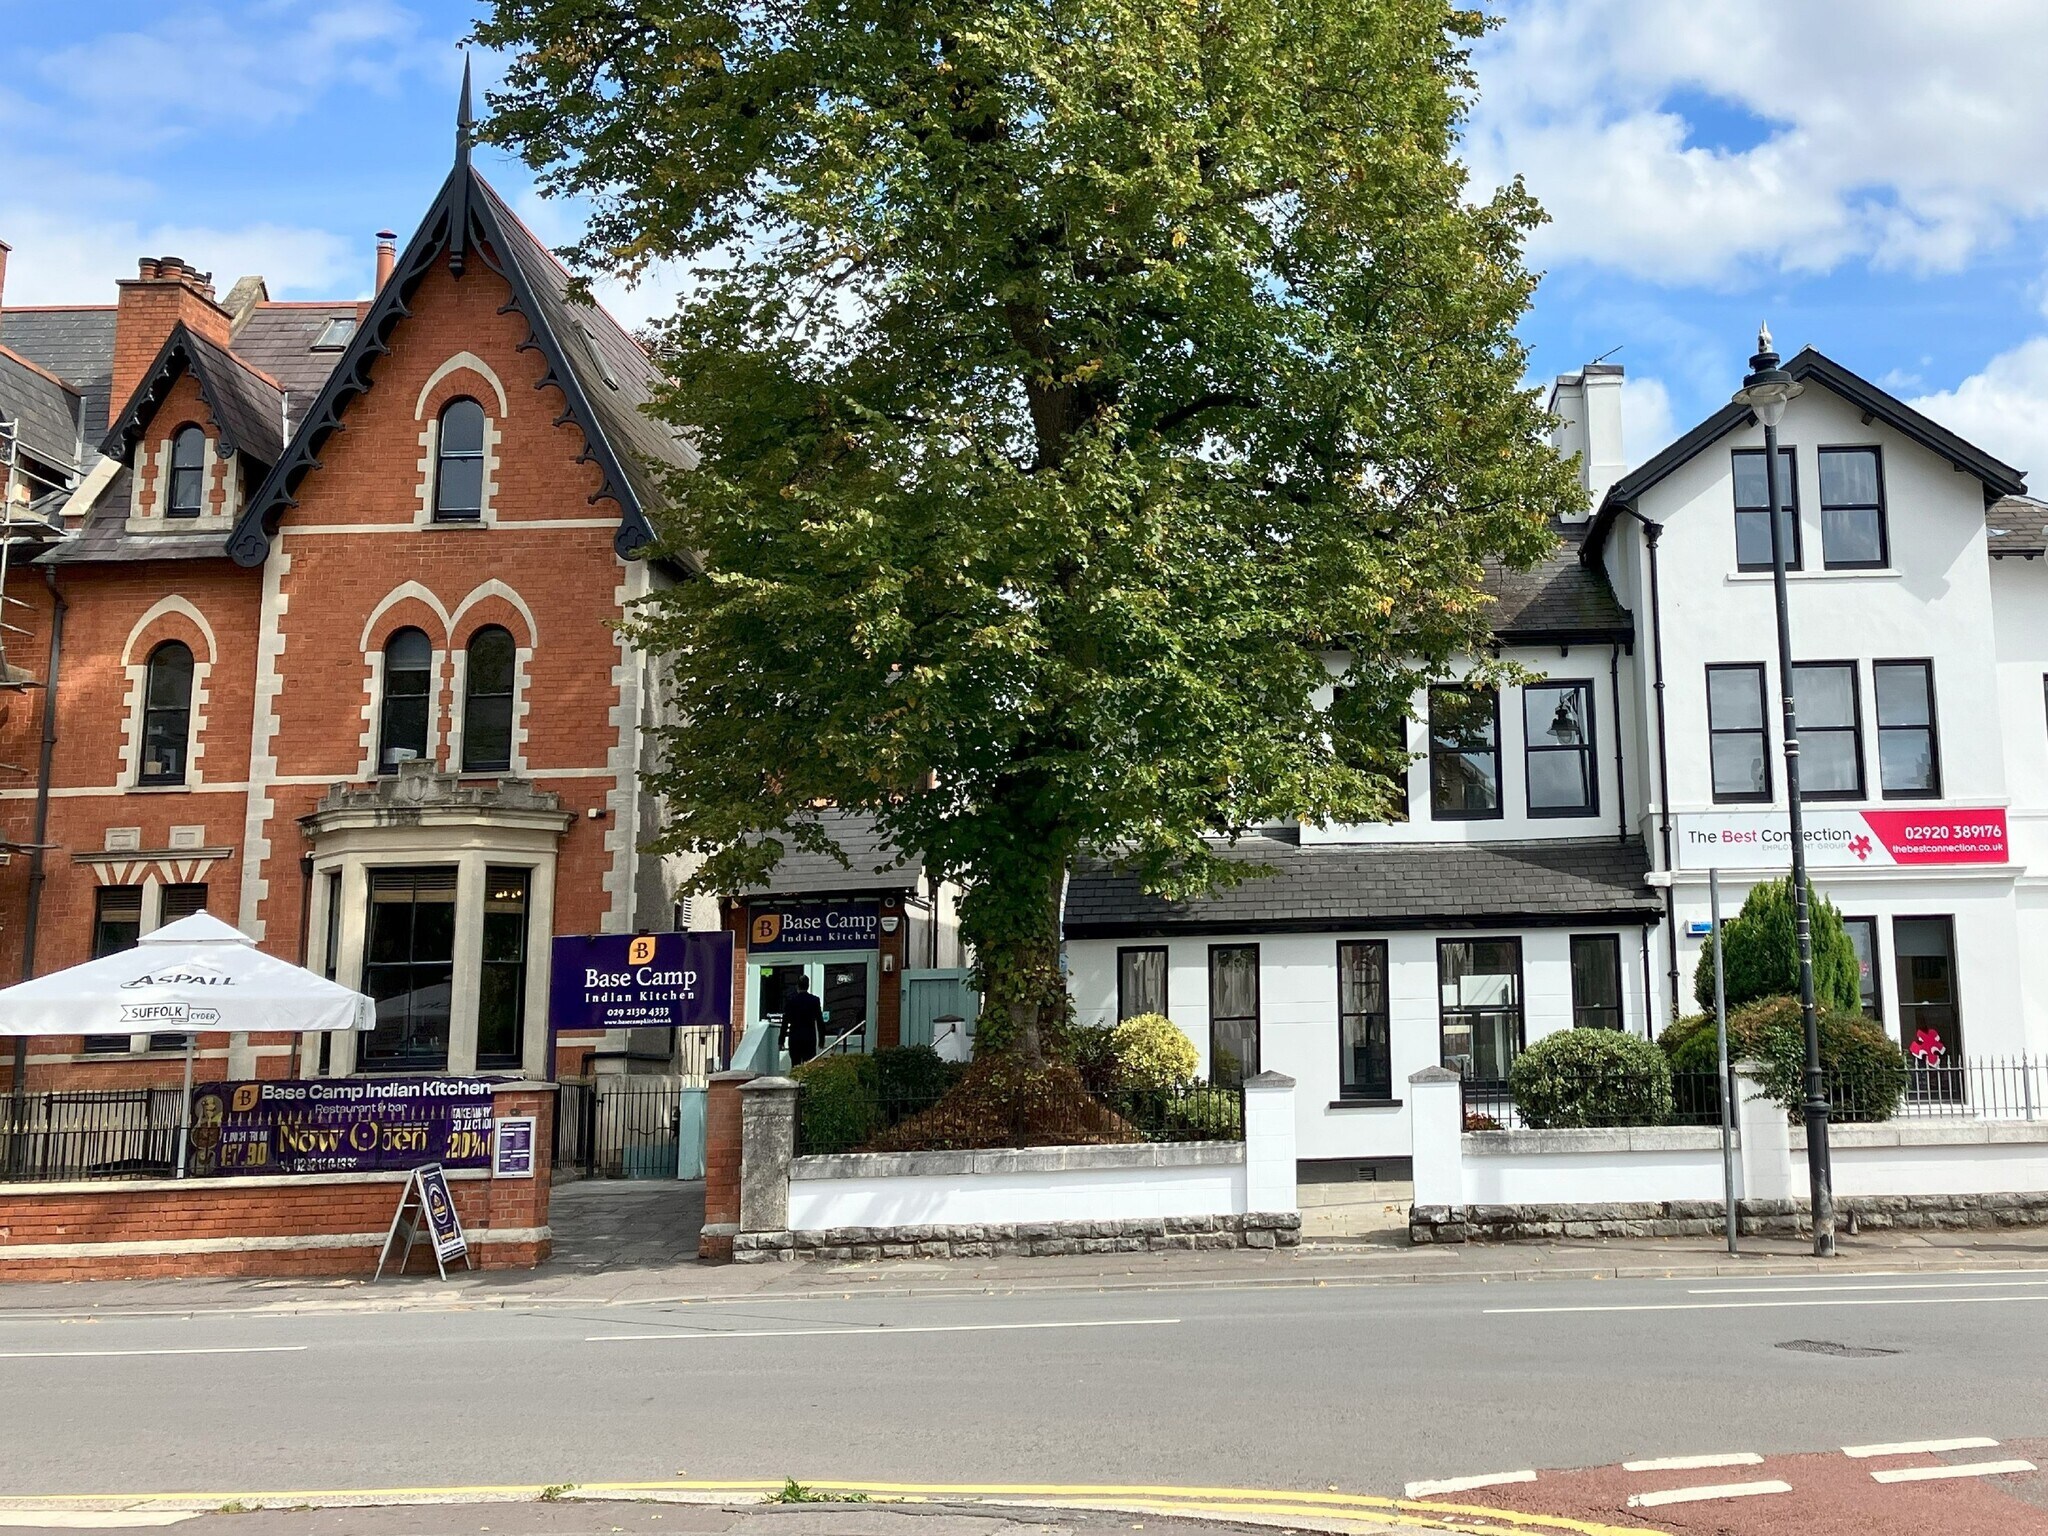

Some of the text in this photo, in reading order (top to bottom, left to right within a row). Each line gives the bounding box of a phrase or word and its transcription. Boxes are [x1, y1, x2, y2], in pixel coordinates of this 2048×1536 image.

[1688, 826, 1852, 844] The Best Conection
[1905, 824, 2002, 840] 02920 389176
[1762, 842, 1847, 851] EMPLONT GROUP
[1892, 842, 2004, 854] thebestconnection.co.uk
[782, 913, 821, 930] Base
[825, 911, 877, 932] Camp
[782, 931, 876, 943] Indian Kitchen
[584, 966, 697, 991] Base Camp
[585, 990, 695, 1003] Indian Kitchen
[131, 1006, 216, 1020] SUFFOLK CYDER
[607, 1006, 670, 1018] 029 2130 4333
[261, 1080, 492, 1102] Base Camp Indian Kitchen
[315, 1103, 376, 1115] Restaurant
[388, 1102, 408, 1113] bar
[278, 1119, 429, 1153] Now Open
